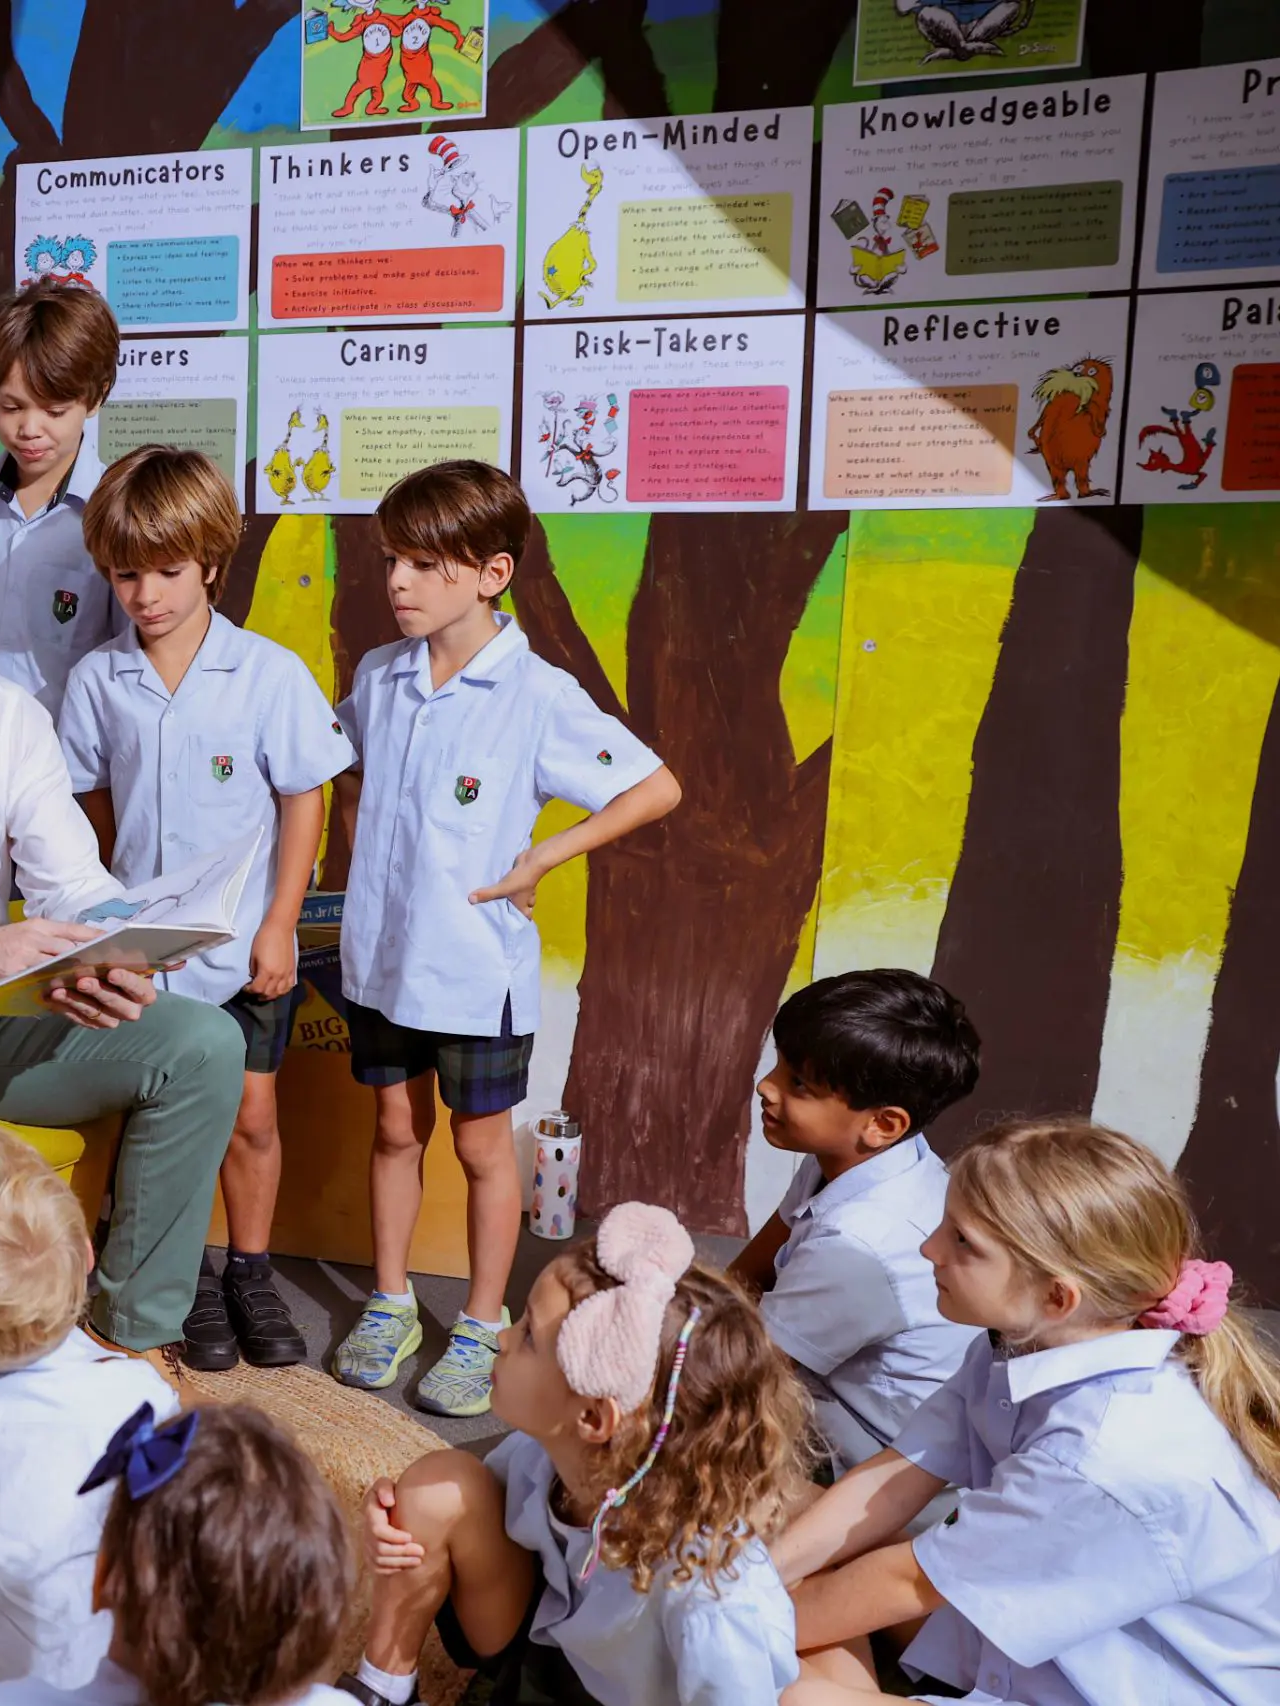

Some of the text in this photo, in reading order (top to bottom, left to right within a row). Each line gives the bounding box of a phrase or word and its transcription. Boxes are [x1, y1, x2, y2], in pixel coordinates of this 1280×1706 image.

[364, 25, 388, 39] THING
[405, 23, 427, 36] THING
[375, 38, 380, 47] 1
[412, 36, 419, 45] 2
[860, 88, 1112, 139] Knowledgeable
[557, 114, 781, 159] Open-Minded
[270, 152, 410, 184] Thinkers
[37, 160, 225, 195] Communicators
[622, 205, 647, 215] When
[693, 232, 707, 241] the
[746, 230, 762, 239] and
[275, 260, 298, 269] When
[319, 258, 332, 266] are
[338, 256, 373, 266] thinkers
[292, 274, 315, 283] Solve
[320, 272, 359, 282] problems
[363, 271, 378, 280] and
[383, 270, 406, 279] make
[410, 269, 430, 280] good
[292, 288, 328, 298] Exercise
[292, 304, 327, 314] Actively
[331, 302, 379, 313] participate
[397, 301, 418, 309] class
[883, 312, 1061, 346] Reflective
[575, 327, 750, 360] Risk-Takers
[117, 349, 189, 366] uirers
[340, 338, 428, 366] Caring
[899, 390, 948, 401] reflective
[345, 414, 368, 422] When
[405, 413, 432, 422] caring
[848, 405, 979, 418] Think critically about the
[362, 427, 383, 436] Show
[430, 427, 477, 436] compassion
[482, 427, 497, 435] and
[868, 423, 893, 432] ideas
[899, 422, 915, 432] and
[361, 442, 392, 450] respect
[412, 441, 423, 450] all
[847, 437, 973, 449] Understand our strengths
[361, 455, 428, 464] Make positive
[378, 470, 398, 478] lives
[846, 468, 980, 480] Know what stage the
[845, 486, 926, 498] learning journey
[315, 905, 343, 917] Jr/E
[298, 1017, 343, 1042] BIG
